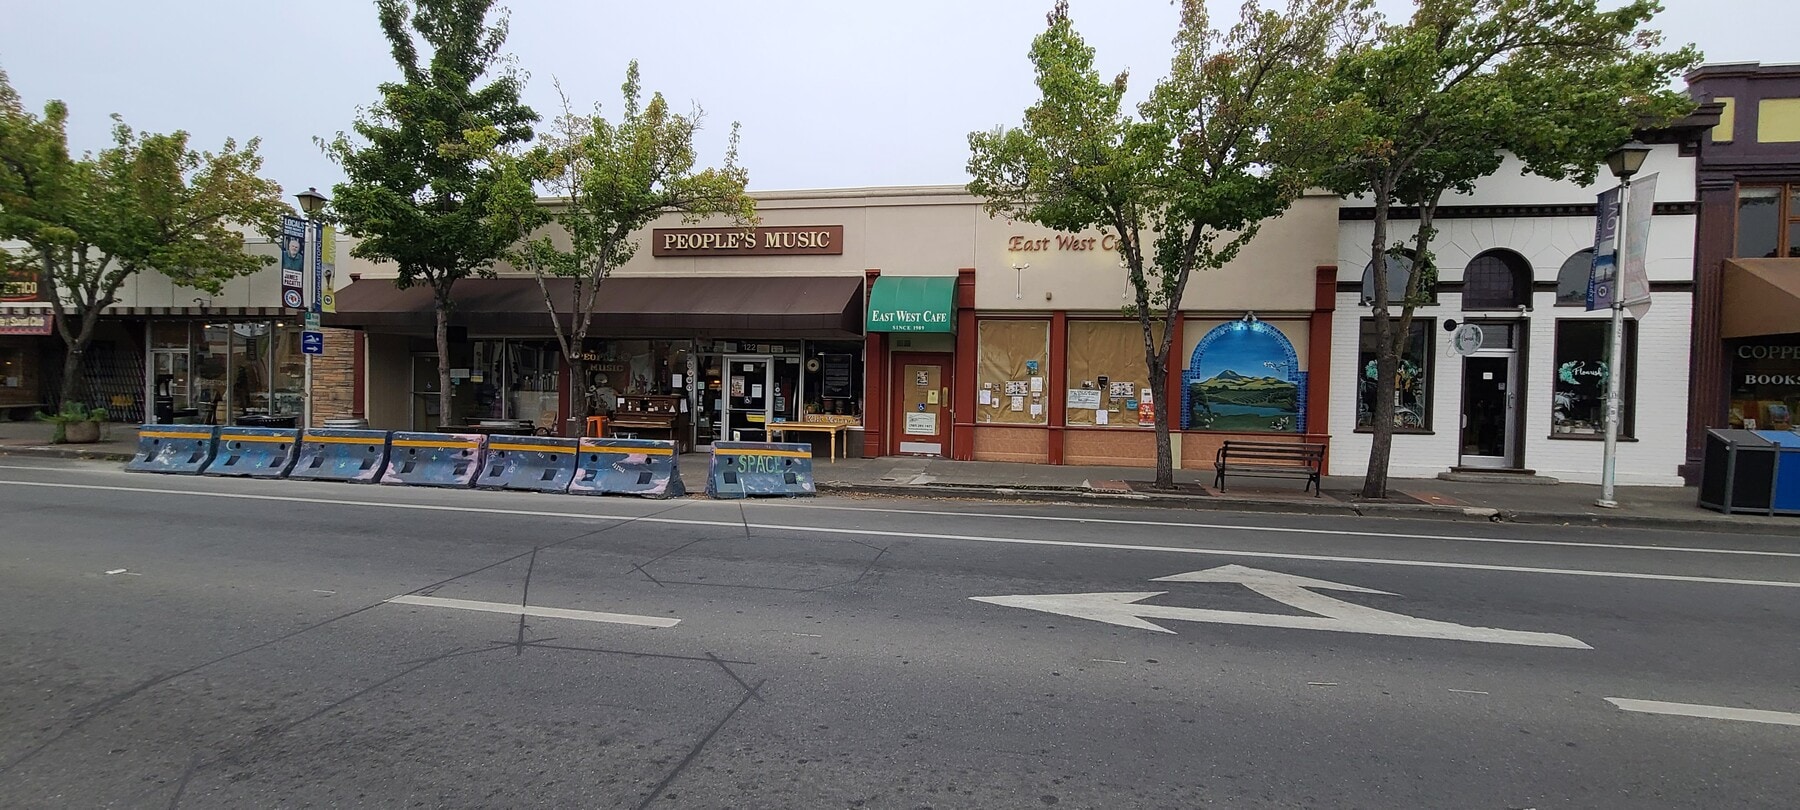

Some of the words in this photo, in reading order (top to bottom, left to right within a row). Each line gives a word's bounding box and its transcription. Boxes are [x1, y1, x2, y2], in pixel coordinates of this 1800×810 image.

[284, 218, 305, 229] LOCALS
[1604, 197, 1617, 240] LOVE
[663, 233, 756, 249] PEOPLE'S
[765, 231, 830, 248] MUSIC
[1008, 236, 1050, 251] East
[1055, 234, 1096, 251] West
[872, 310, 895, 322] EAST
[896, 310, 921, 322] WEST
[923, 310, 947, 322] CAFE
[590, 364, 624, 372] MUSIC
[1572, 361, 1603, 376] Flourish
[738, 455, 784, 474] SPACE
